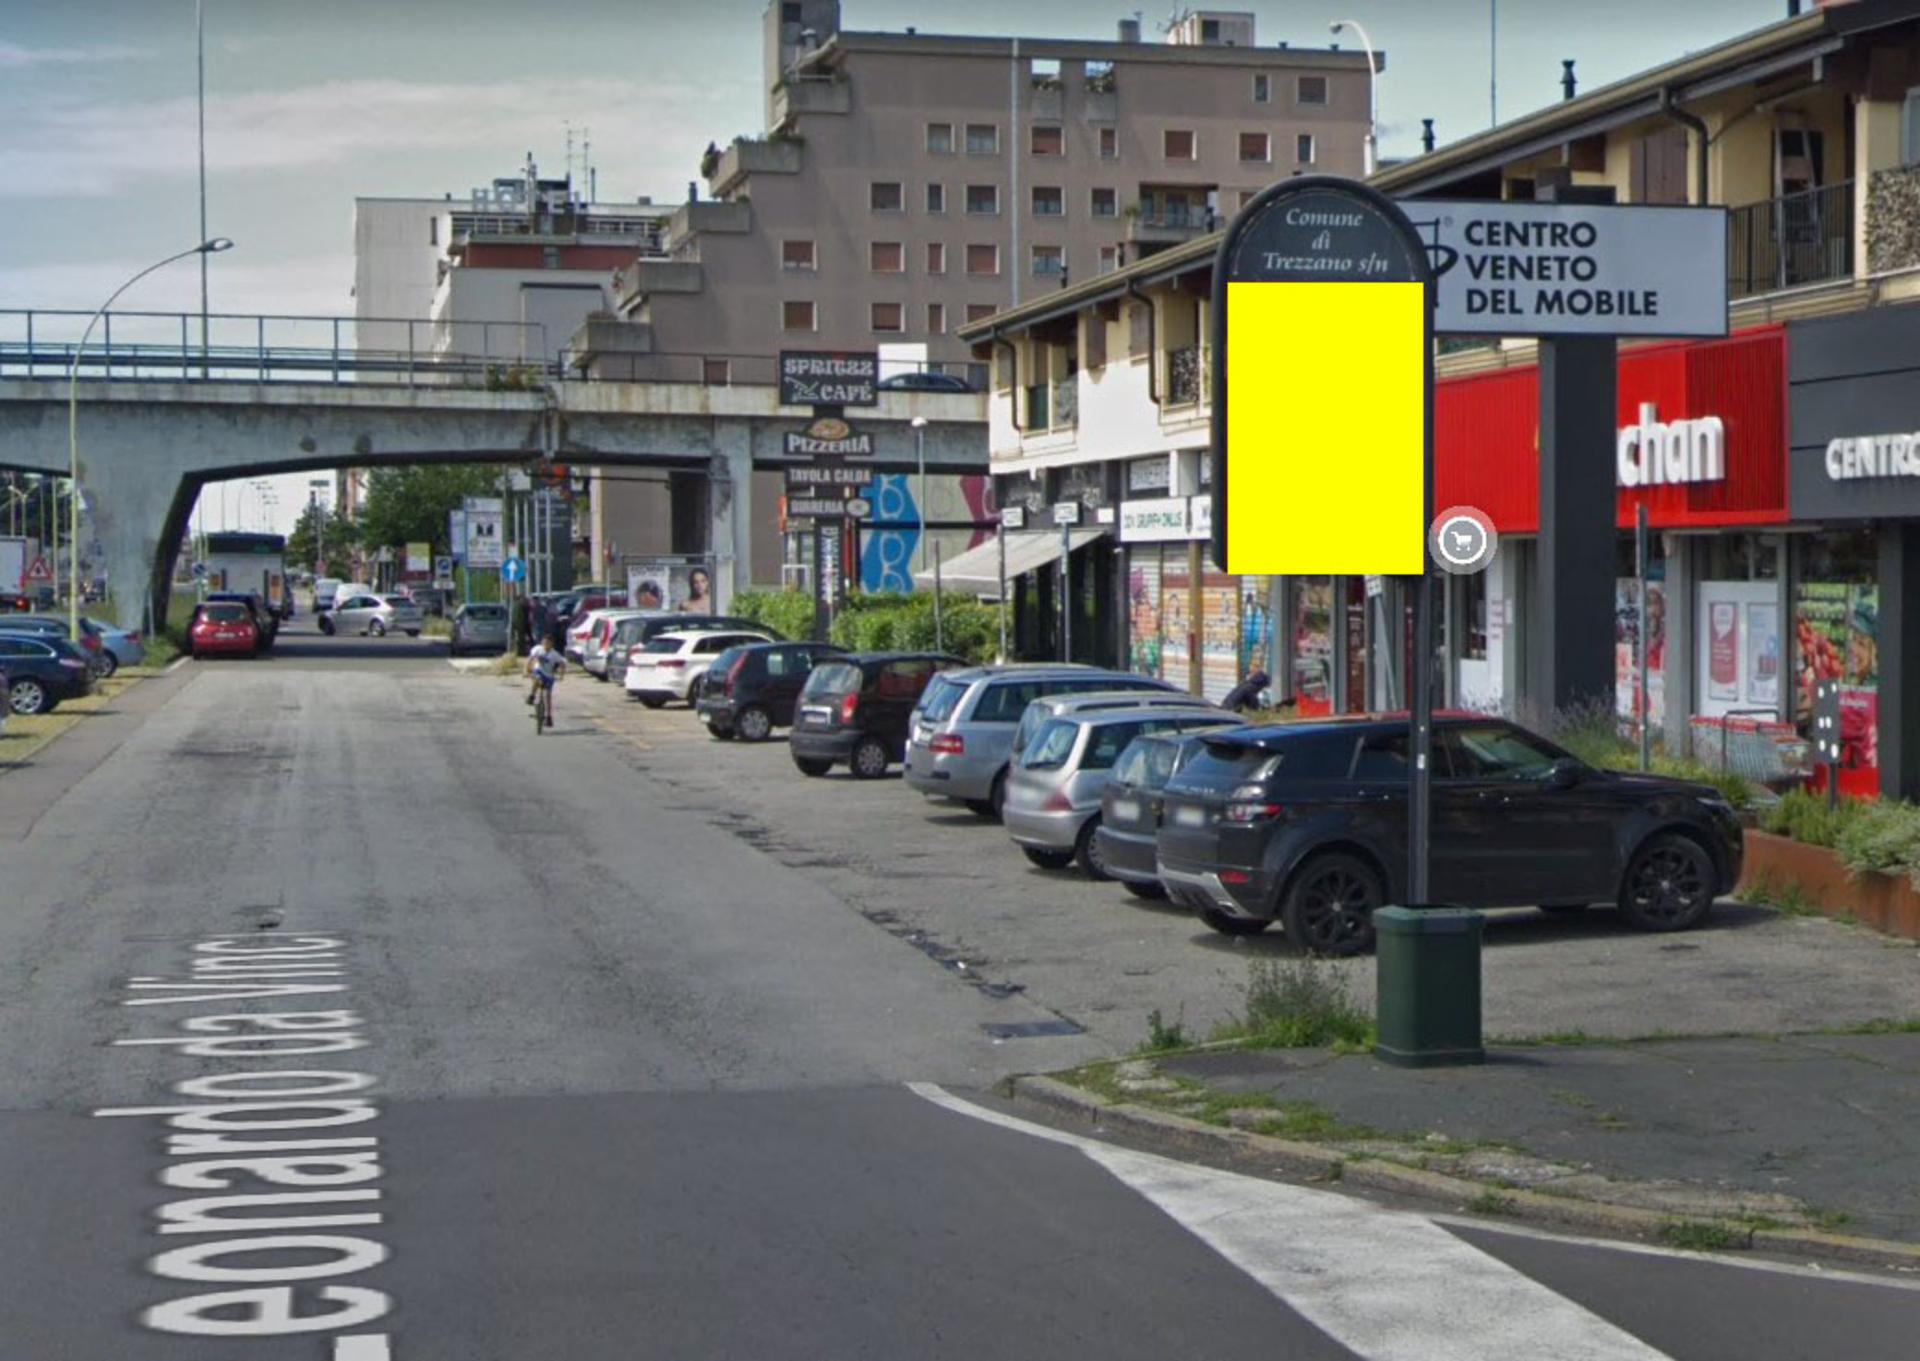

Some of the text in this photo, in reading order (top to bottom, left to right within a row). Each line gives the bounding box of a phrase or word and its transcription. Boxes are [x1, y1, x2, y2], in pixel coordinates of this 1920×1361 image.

[1285, 208, 1364, 227] Comune
[1311, 230, 1331, 250] di
[1464, 219, 1598, 249] CENTRO
[1262, 251, 1389, 276] Trezzano s/n
[1464, 254, 1598, 282] VENETO
[1466, 288, 1658, 317] DEL MOBILE
[820, 381, 873, 402] CAFÉ
[788, 433, 871, 453] PIZZERIA
[1617, 402, 1725, 487] chan
[789, 468, 871, 484] TAVOLA CALDA
[112, 1010, 364, 1056] da
[94, 1069, 390, 1361] eonardo
